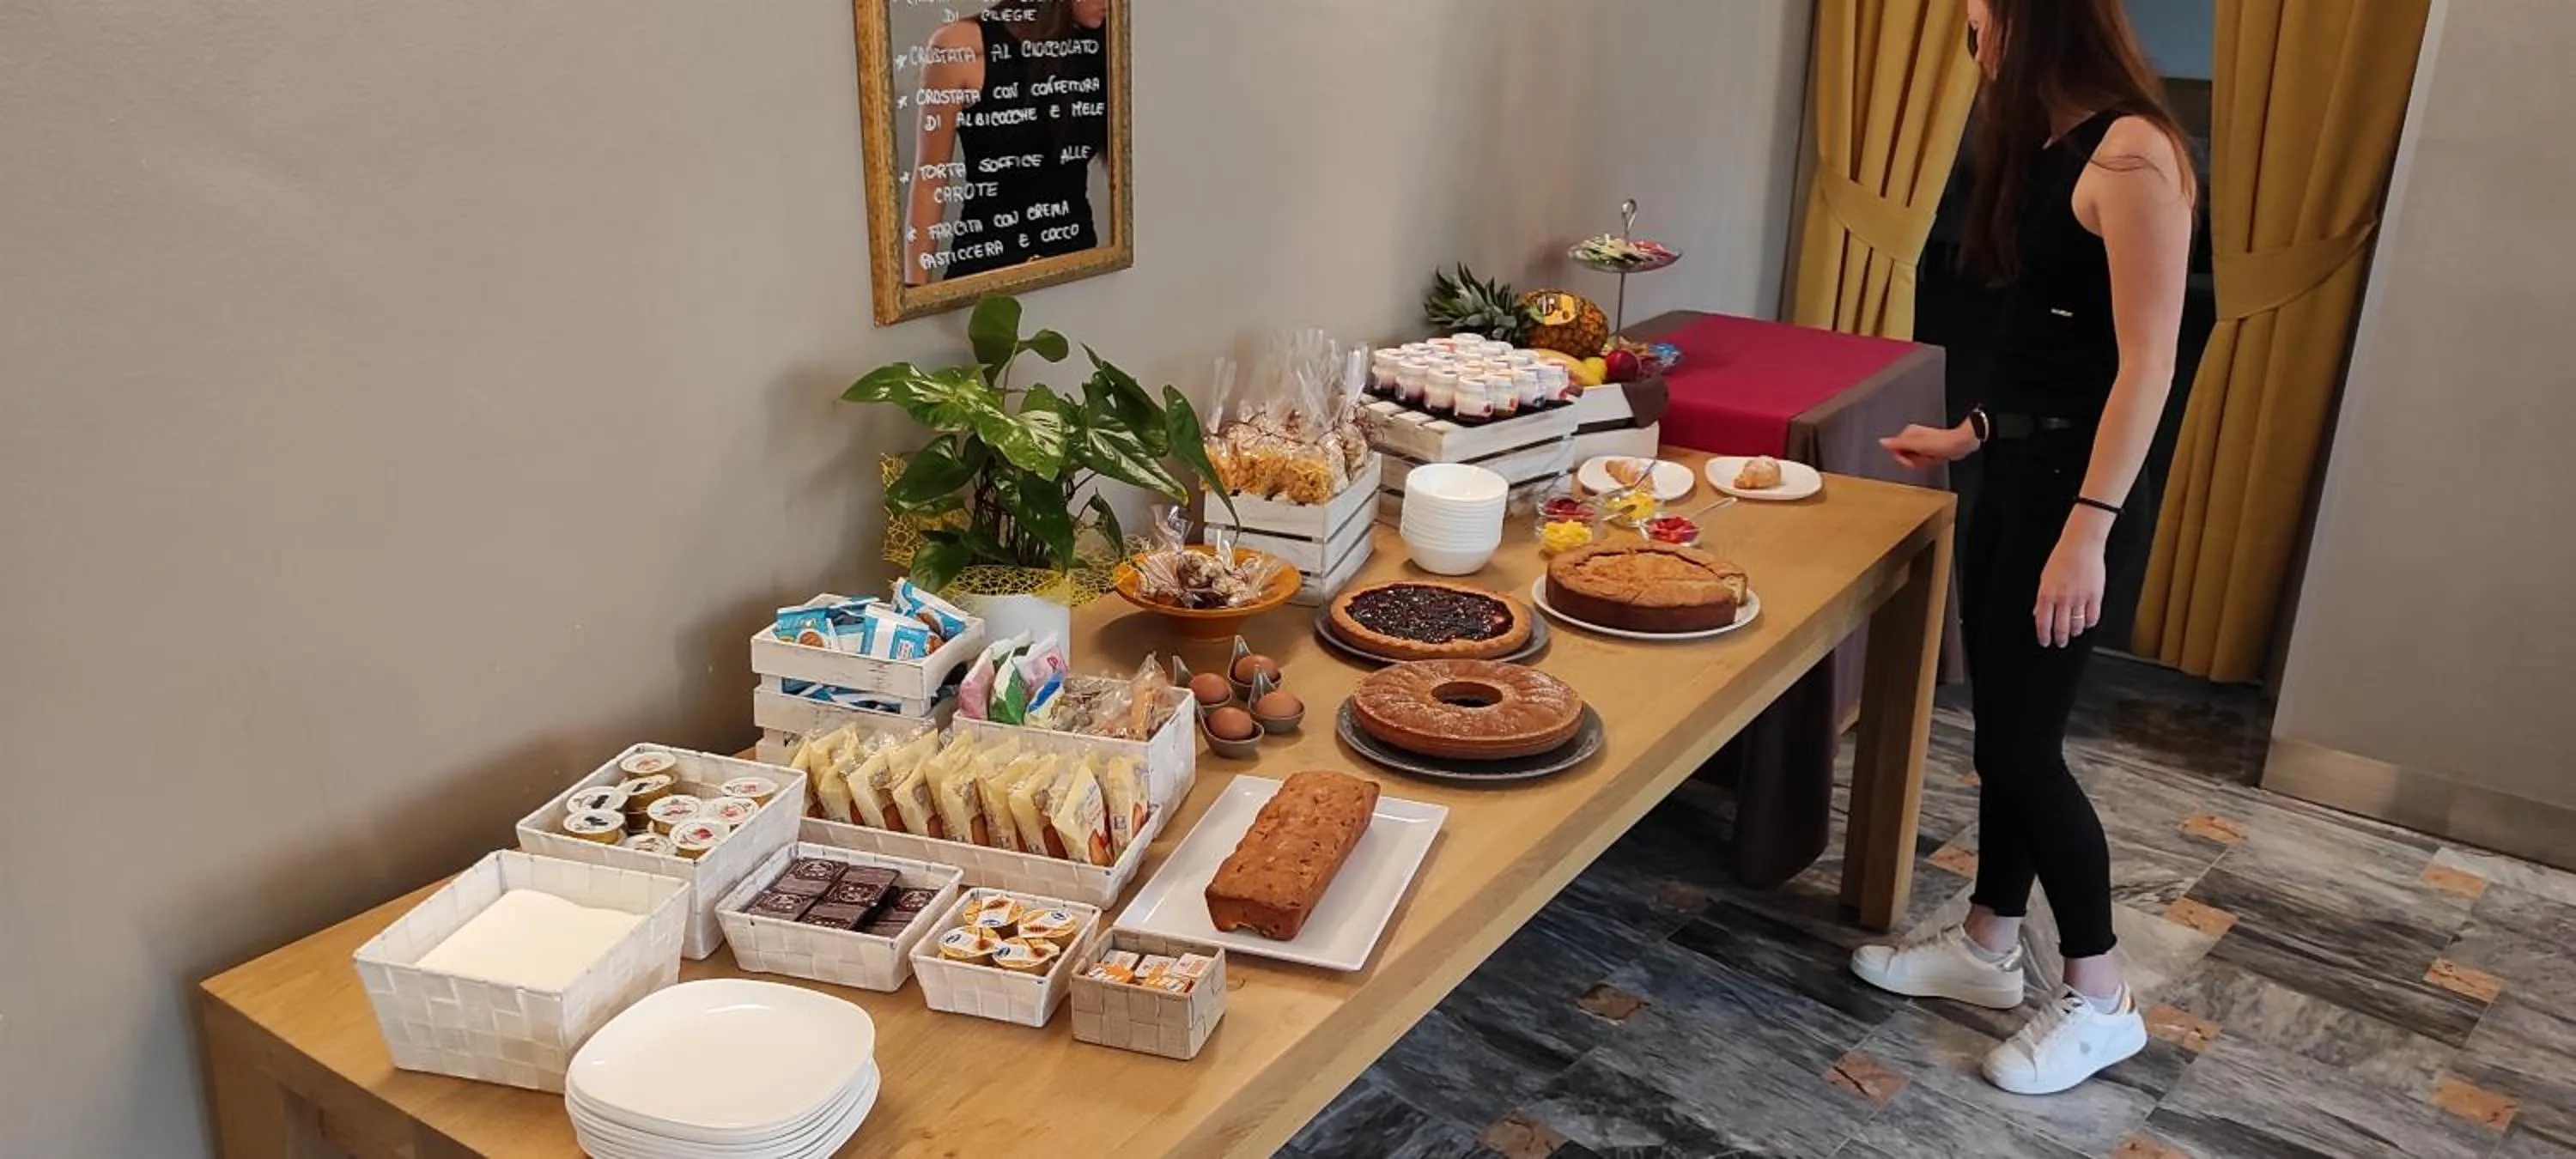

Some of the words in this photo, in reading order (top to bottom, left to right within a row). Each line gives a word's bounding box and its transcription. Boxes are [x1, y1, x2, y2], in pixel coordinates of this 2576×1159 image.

[945, 9, 959, 22] DI
[909, 46, 976, 64] CROSTATA
[991, 45, 1012, 62] AL
[1021, 39, 1099, 58] CIOCCOLATO
[915, 88, 981, 105] CROSTATA
[993, 82, 1018, 100] CON
[1031, 76, 1100, 96] CONFETTURA
[925, 114, 941, 131] DI
[956, 107, 1037, 128] ALBICOCCHE
[1049, 104, 1060, 118] E
[1072, 101, 1104, 117] MELE
[919, 161, 966, 181] TORTA
[978, 155, 1044, 173] SOFFICE
[1060, 145, 1091, 164] ALLE
[933, 182, 999, 203] CAROTE
[928, 220, 982, 240] FARCITA
[993, 211, 1019, 228] CON
[1027, 201, 1070, 220] CREMA
[920, 240, 1004, 270] PASTICCERA
[1018, 233, 1030, 247] E
[1041, 224, 1078, 242] COCCO
